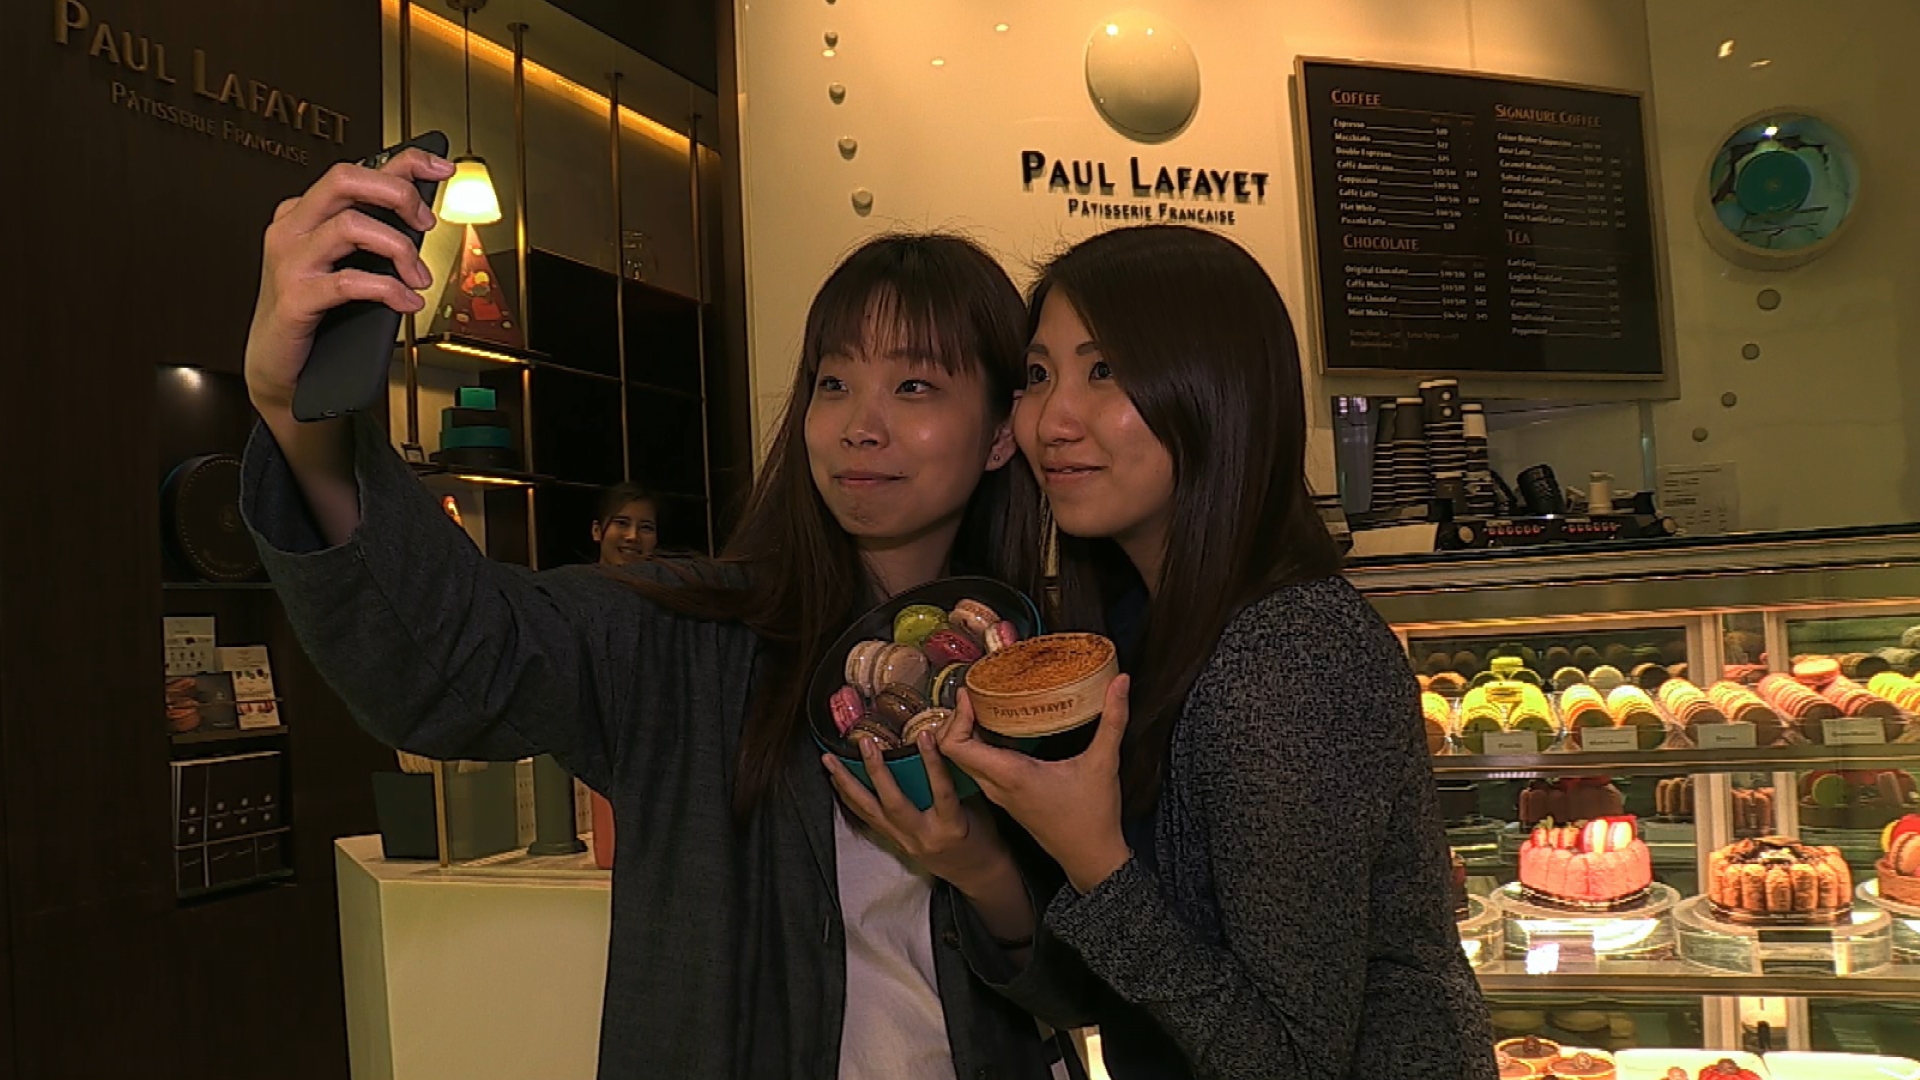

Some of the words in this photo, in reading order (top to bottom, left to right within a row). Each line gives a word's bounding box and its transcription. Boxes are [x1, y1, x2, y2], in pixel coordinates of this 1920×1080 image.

[54, 0, 177, 84] PAUL
[193, 48, 350, 145] LAFAYET
[1330, 90, 1381, 106] COFFEE
[1495, 104, 1558, 123] SIGNATURE
[1559, 110, 1602, 128] COFFEE
[1021, 150, 1116, 194] PAUL
[1130, 156, 1270, 203] LAFAYET
[1360, 189, 1379, 199] Latte
[1355, 203, 1377, 212] White
[1343, 233, 1420, 251] CHOCOLATE
[1506, 229, 1531, 244] TEA
